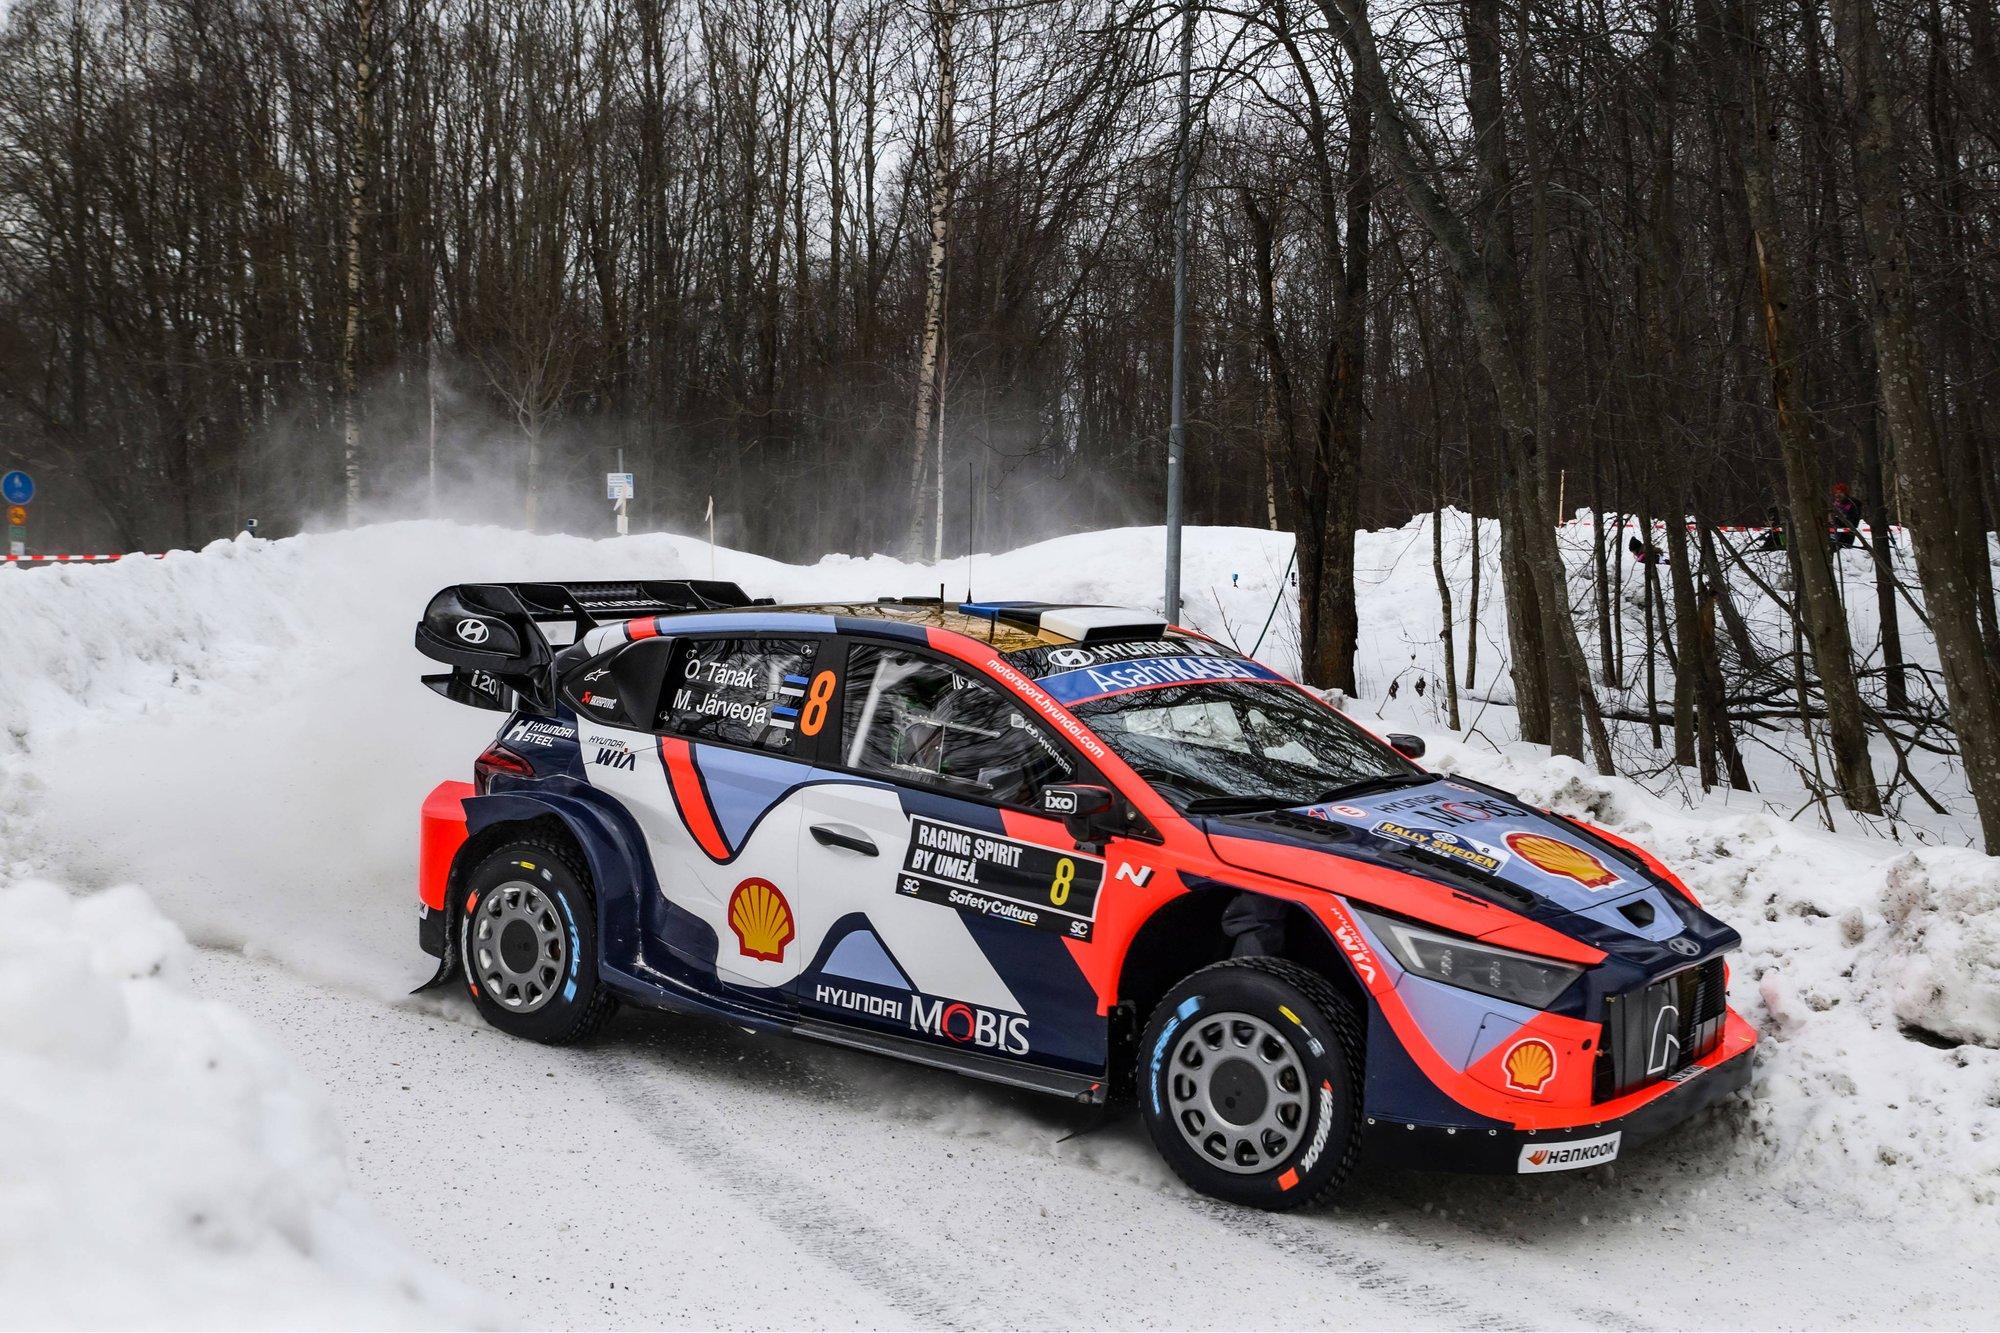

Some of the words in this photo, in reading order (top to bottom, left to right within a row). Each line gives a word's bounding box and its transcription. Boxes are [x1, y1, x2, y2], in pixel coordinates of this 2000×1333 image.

[1091, 641, 1187, 659] HYUNDAI
[684, 659, 700, 680] O.
[706, 662, 757, 689] Tänak
[1086, 658, 1258, 692] AsahiKASEI
[672, 689, 691, 711] M.
[696, 694, 767, 727] Järveoja
[800, 669, 837, 737] 8
[986, 659, 1105, 759] motorsport.hyundai.com
[523, 732, 553, 747] STEEL
[530, 722, 575, 738] HYUNDAI
[589, 736, 626, 749] HYUNDAI
[596, 747, 636, 771] WIA
[1038, 736, 1072, 775] HYUNDAI
[1413, 799, 1529, 828] MOBIS
[918, 824, 971, 858] RACING
[974, 838, 1023, 868] SPIRIT
[1382, 823, 1429, 843] RALLY
[1431, 840, 1499, 868] SWEDEN
[911, 849, 931, 871] BY
[934, 856, 979, 884] UMEÅ.
[1050, 858, 1075, 906] 8
[903, 877, 919, 892] SC
[949, 890, 1039, 923] SafetyCulture
[1070, 920, 1088, 935] SC
[816, 985, 903, 1020] HYUNDAI
[909, 995, 1030, 1055] MOBIS
